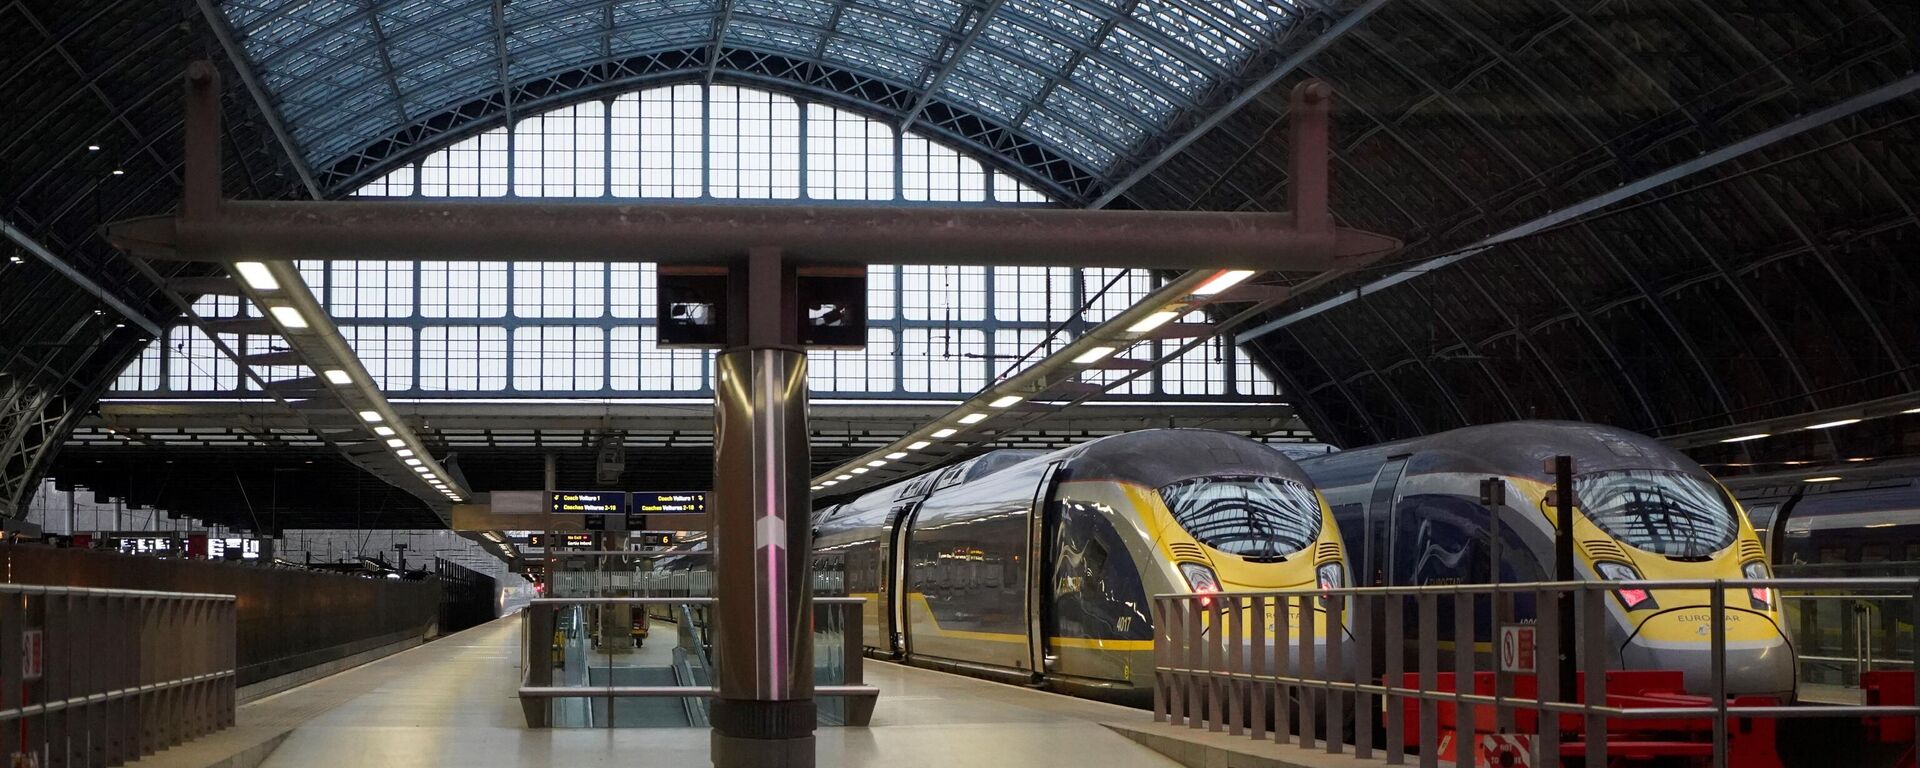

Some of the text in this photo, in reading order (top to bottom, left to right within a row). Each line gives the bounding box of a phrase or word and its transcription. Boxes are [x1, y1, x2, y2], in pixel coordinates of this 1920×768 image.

[532, 536, 538, 545] 5
[662, 536, 669, 544] 6
[1678, 614, 1740, 622] EUROAR
[1117, 616, 1132, 632] 4017
